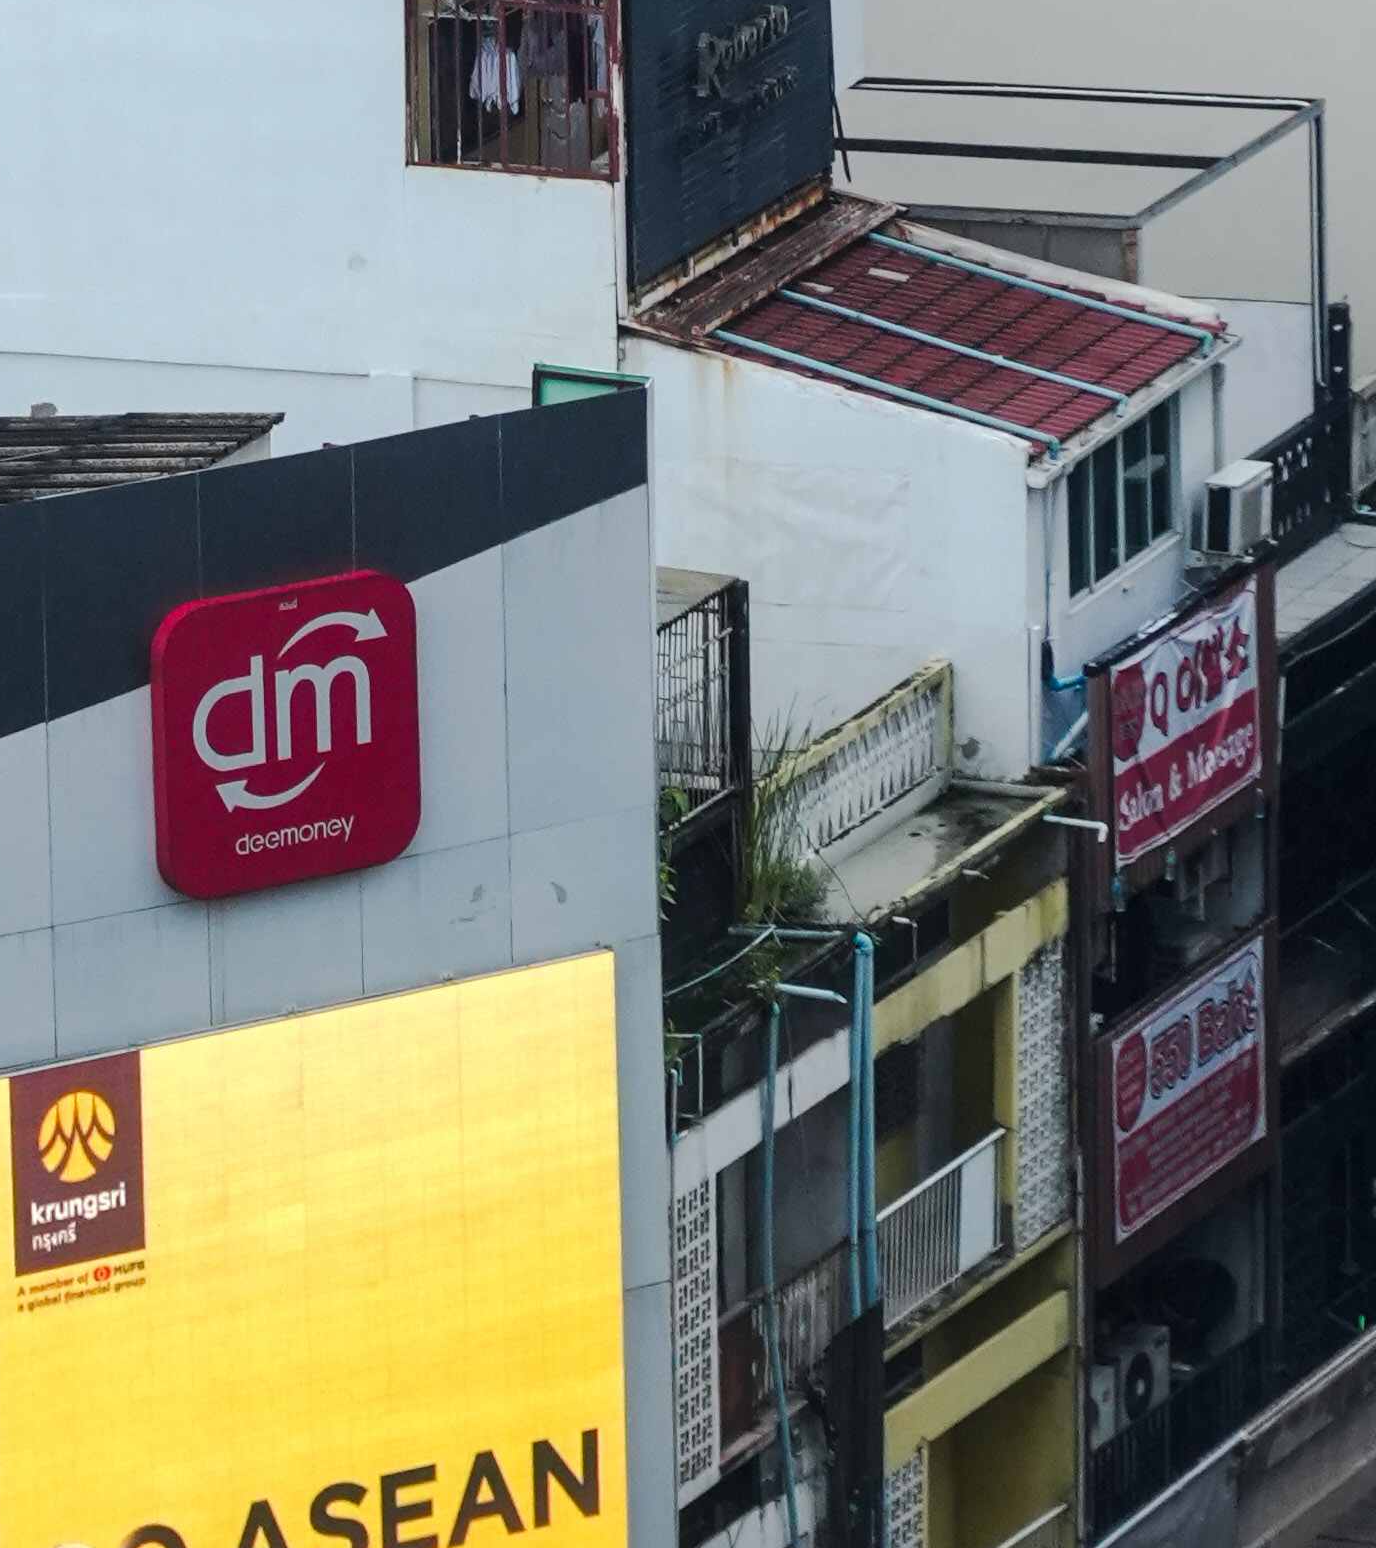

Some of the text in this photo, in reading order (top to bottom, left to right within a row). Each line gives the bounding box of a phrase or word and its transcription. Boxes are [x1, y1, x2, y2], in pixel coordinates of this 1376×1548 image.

[192, 654, 373, 772] dm
[235, 814, 354, 856] deemoney
[30, 1181, 127, 1226] krungsri
